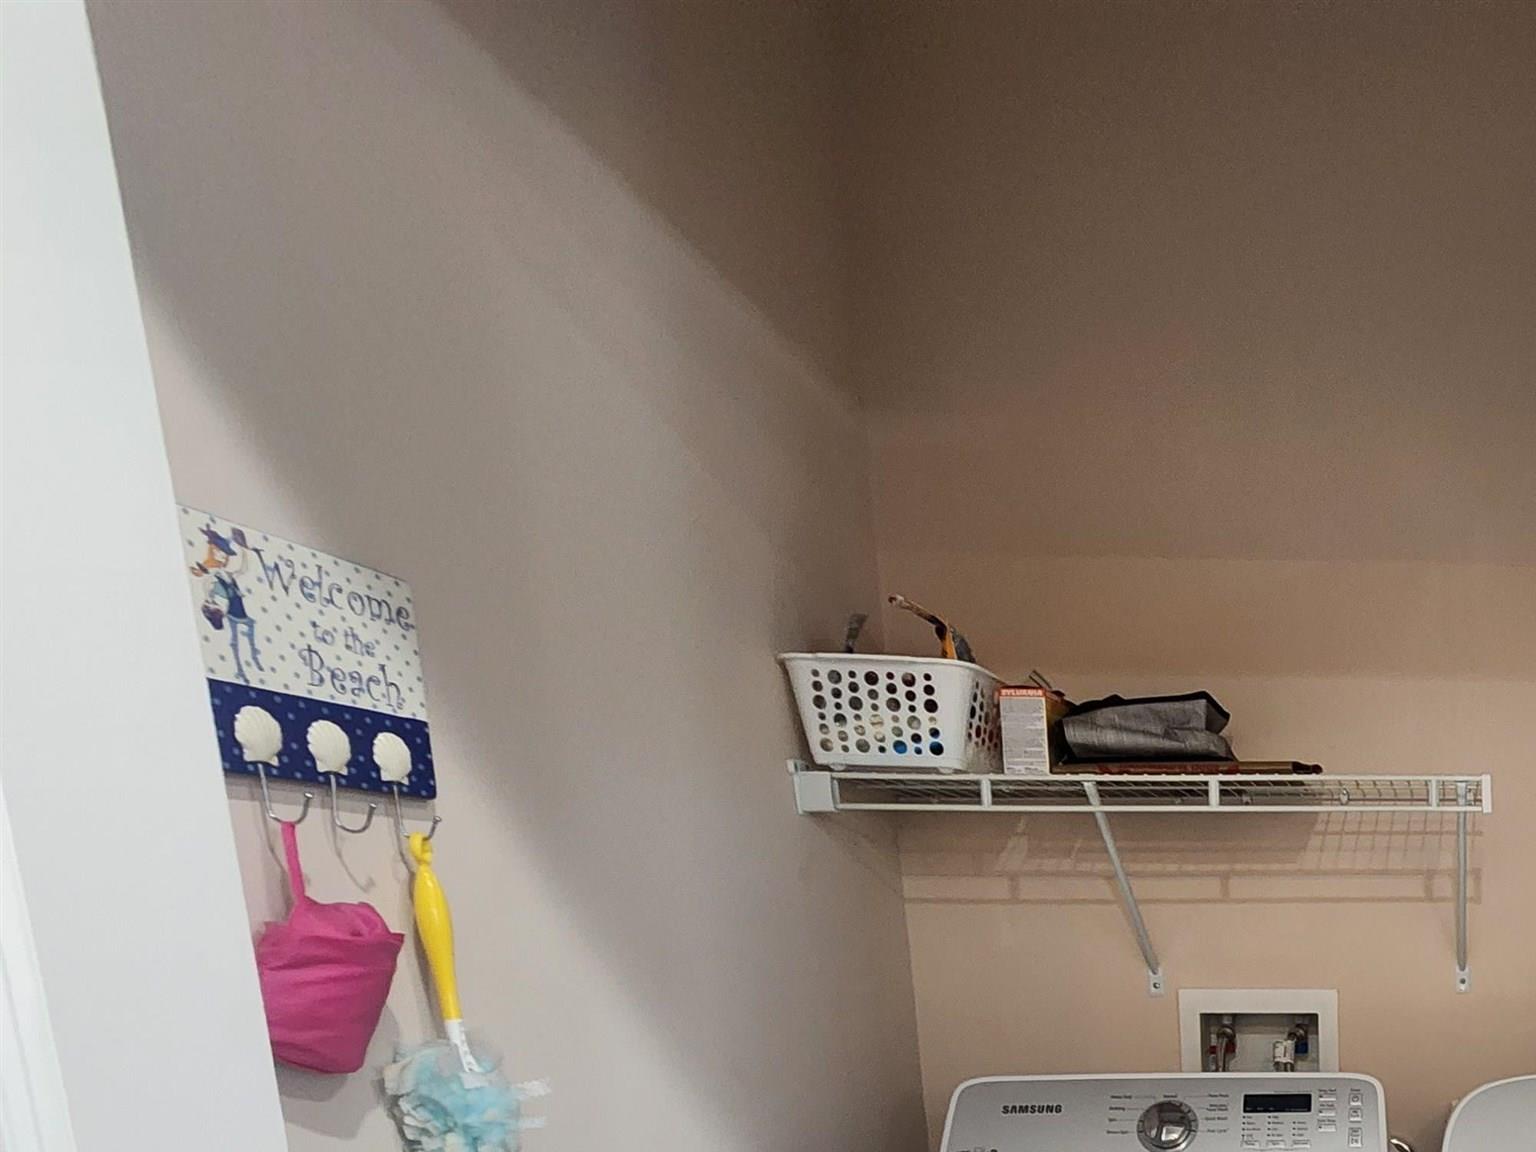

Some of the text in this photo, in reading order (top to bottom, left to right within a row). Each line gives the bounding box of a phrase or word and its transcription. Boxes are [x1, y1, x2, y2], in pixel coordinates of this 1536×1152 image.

[251, 547, 415, 632] Welcome
[310, 620, 376, 658] to the
[298, 644, 406, 710] Beach
[1001, 1104, 1063, 1115] SAMSUNG
